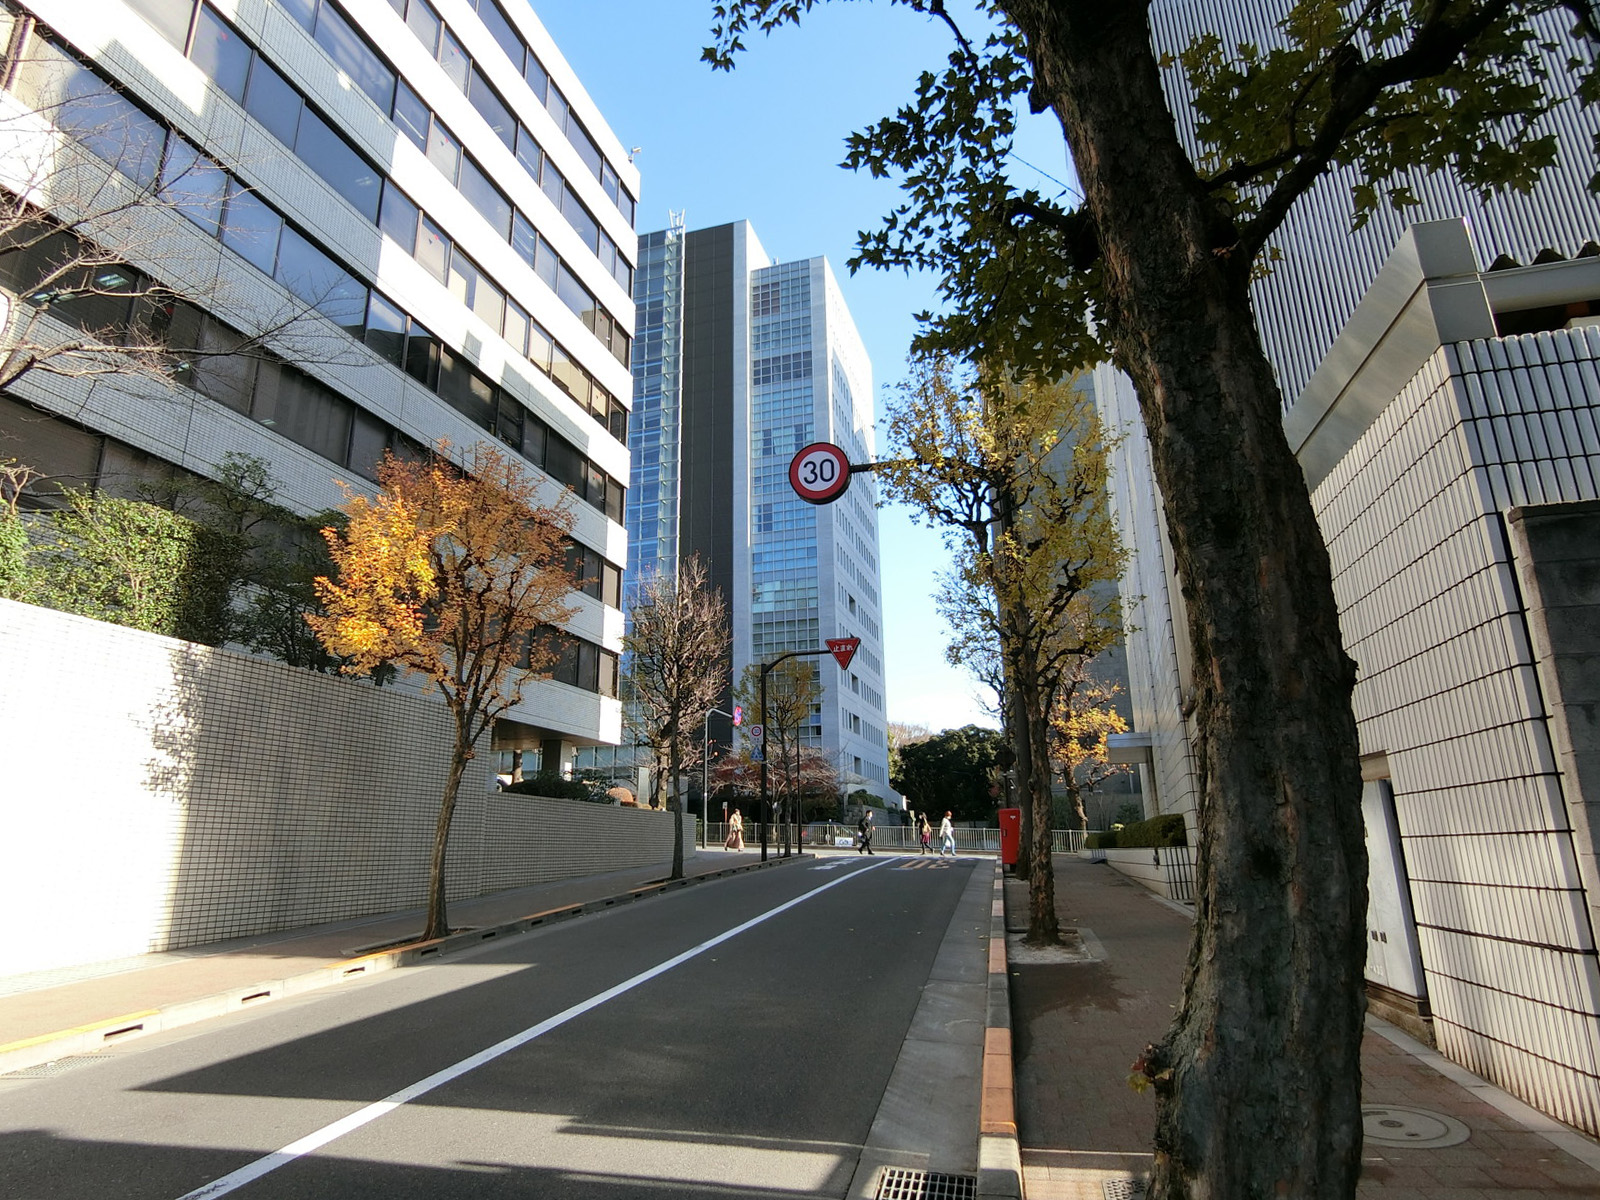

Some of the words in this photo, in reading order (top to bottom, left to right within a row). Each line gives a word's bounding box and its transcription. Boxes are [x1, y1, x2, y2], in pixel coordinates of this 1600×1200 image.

[803, 458, 835, 485] 30
[833, 644, 854, 653] 止まれ
